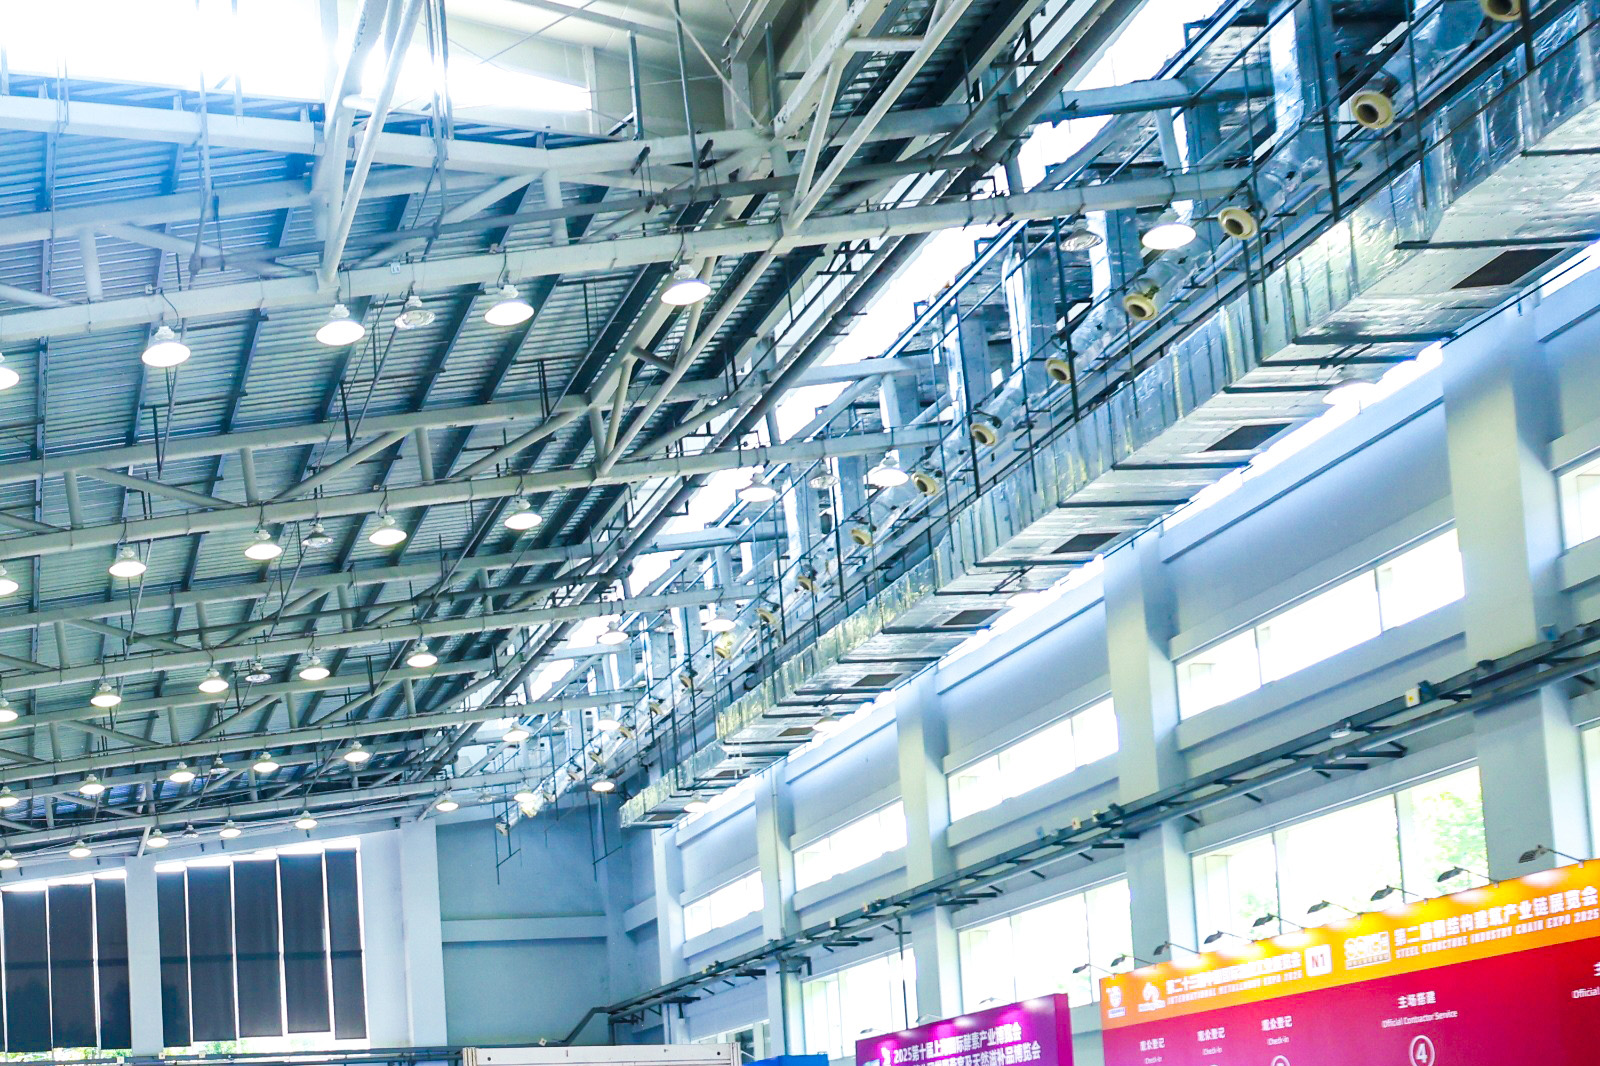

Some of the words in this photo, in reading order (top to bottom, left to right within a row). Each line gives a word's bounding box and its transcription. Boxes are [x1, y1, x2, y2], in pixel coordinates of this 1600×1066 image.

[1546, 914, 1571, 928] EXPO
[1574, 908, 1600, 924] 2025
[1311, 953, 1326, 968] N1
